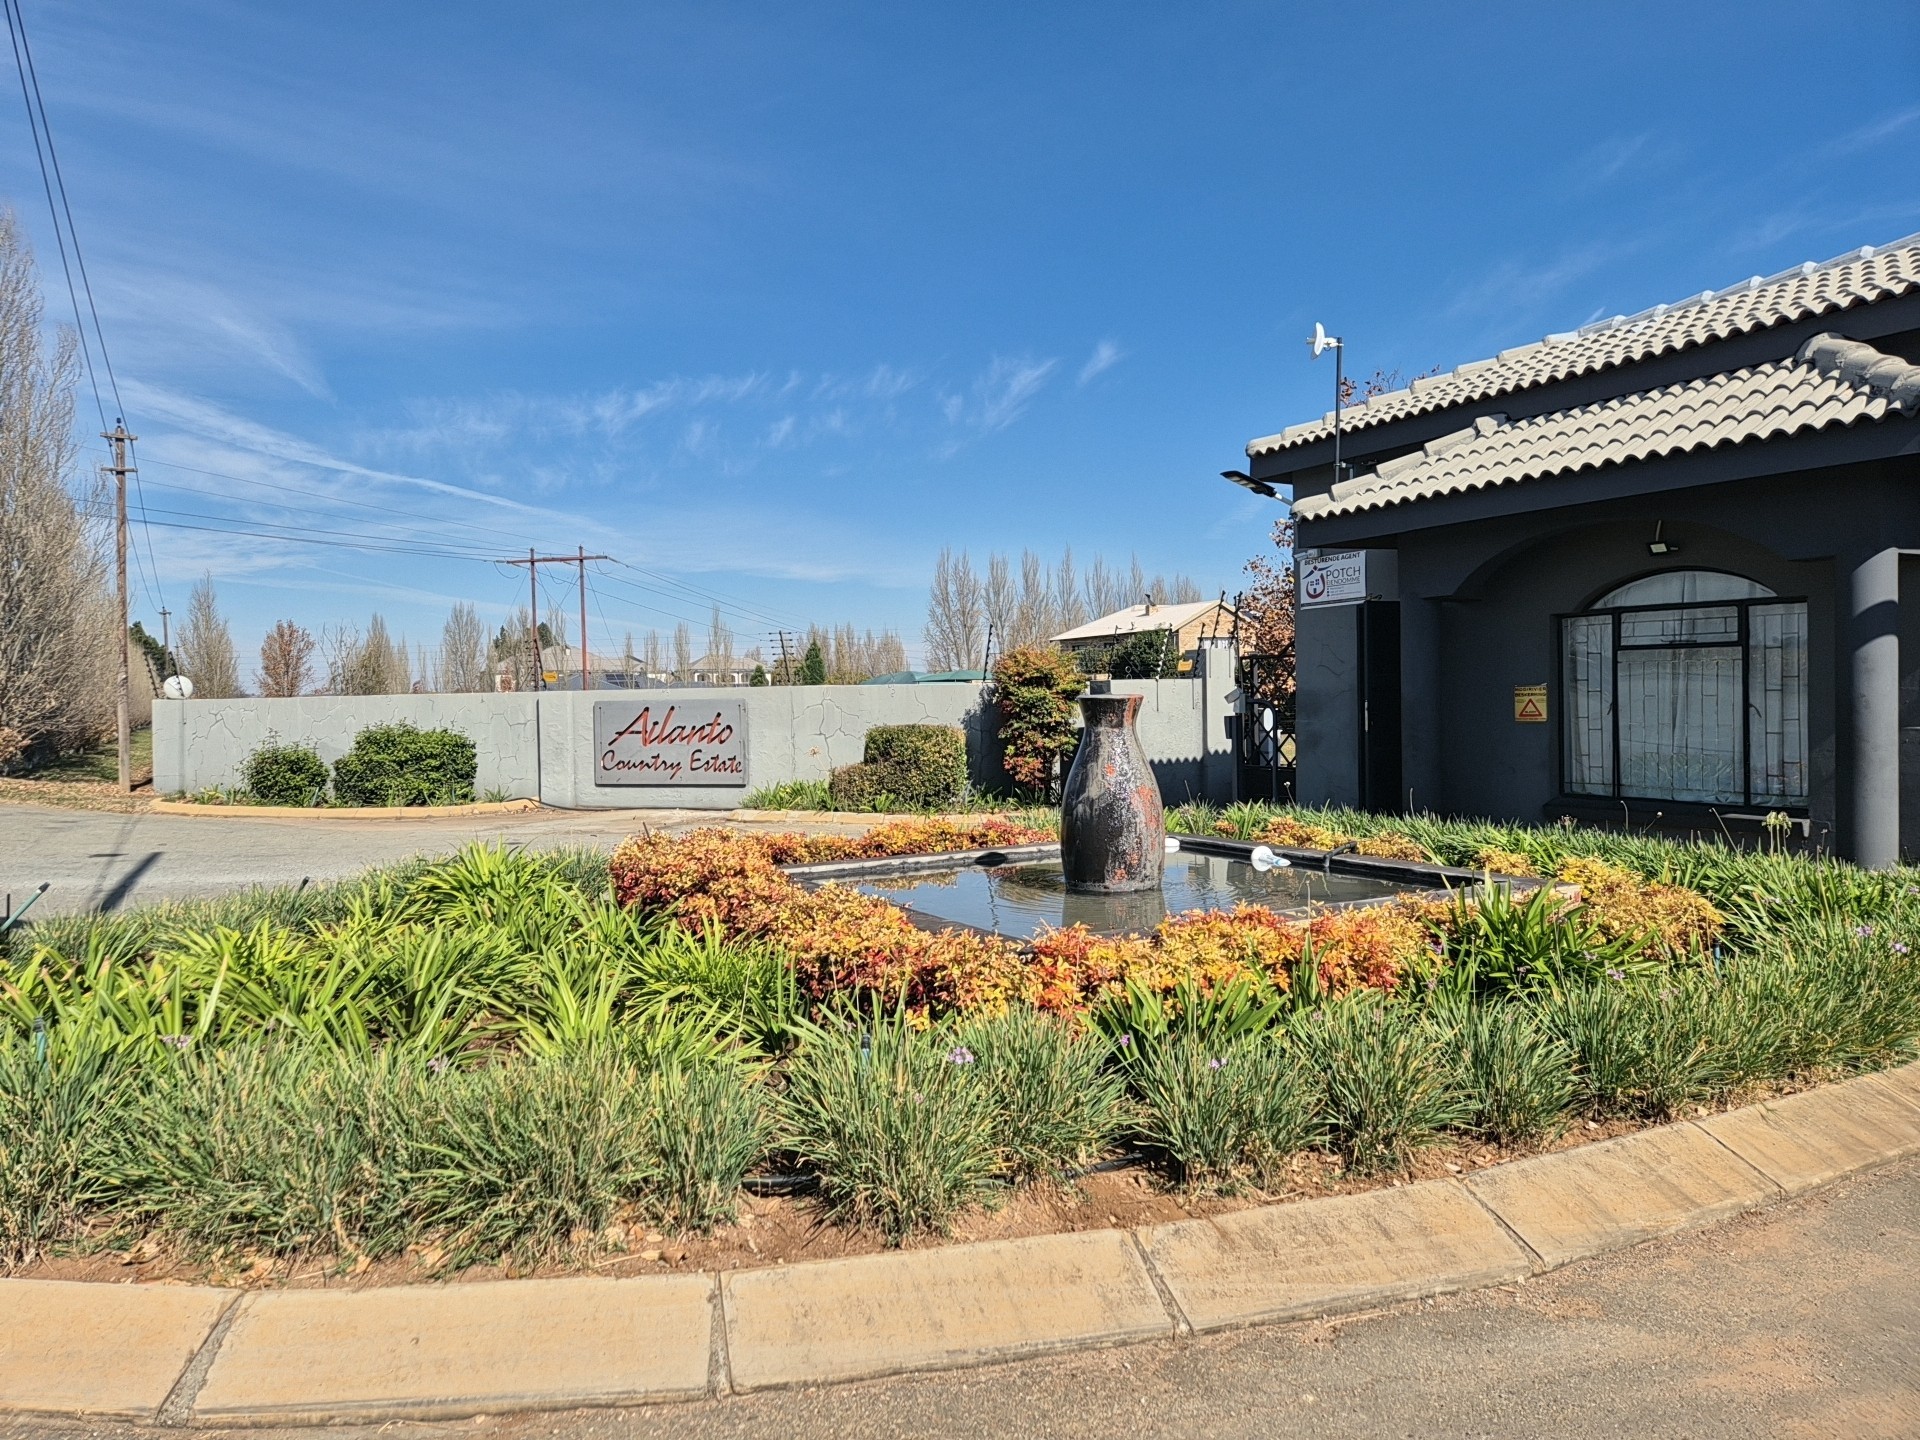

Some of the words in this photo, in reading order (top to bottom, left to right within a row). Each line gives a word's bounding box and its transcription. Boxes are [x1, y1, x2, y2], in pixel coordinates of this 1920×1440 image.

[1304, 555, 1340, 565] BESTURENDE
[1341, 551, 1360, 560] AGENT
[1326, 566, 1360, 580] POTCH
[607, 705, 733, 747] Ailanto
[602, 749, 682, 780] Country
[690, 749, 743, 774] Estate
